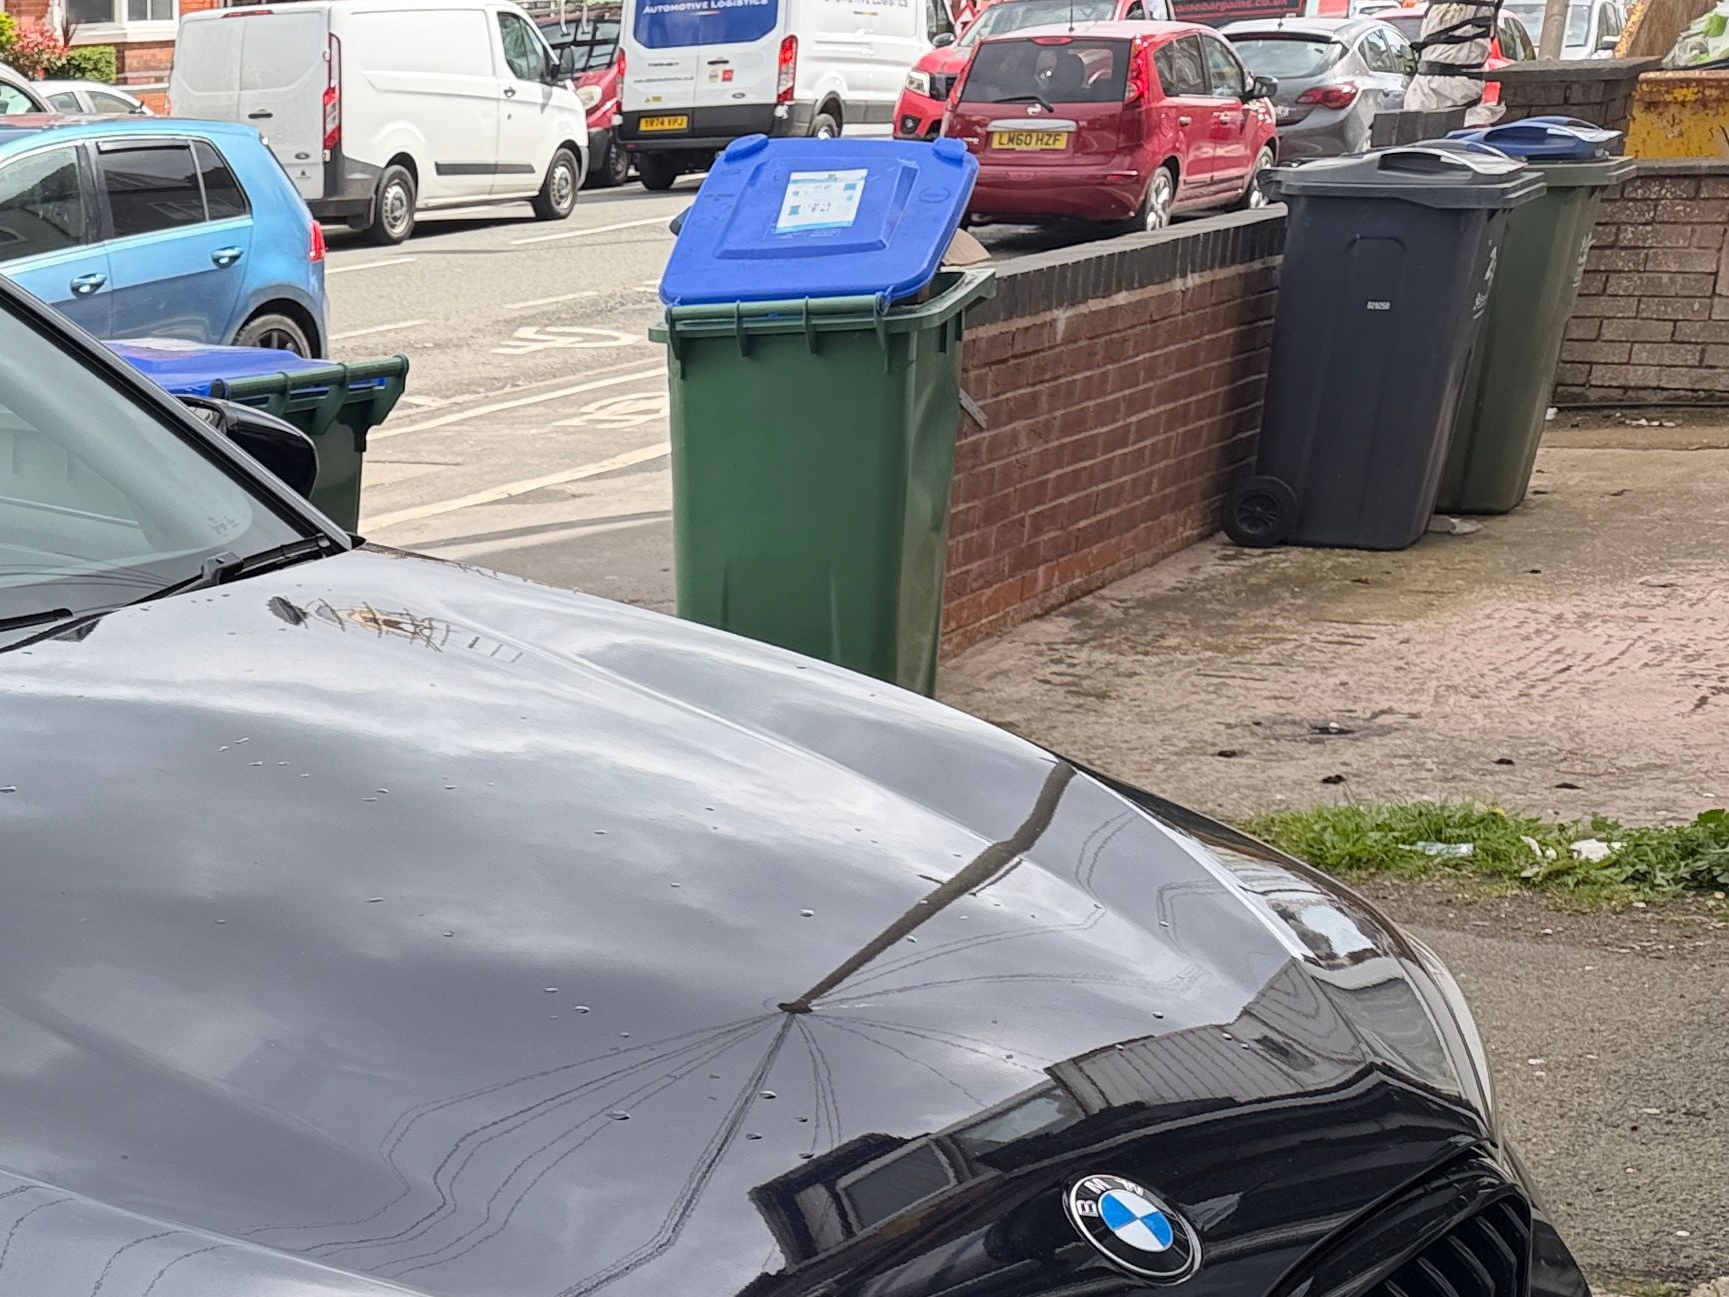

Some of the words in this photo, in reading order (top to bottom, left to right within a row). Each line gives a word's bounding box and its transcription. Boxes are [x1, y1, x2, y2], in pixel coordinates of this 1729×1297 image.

[998, 133, 1032, 146] LM60
[1035, 133, 1062, 145] HZF
[1076, 1177, 1145, 1218] BMW
